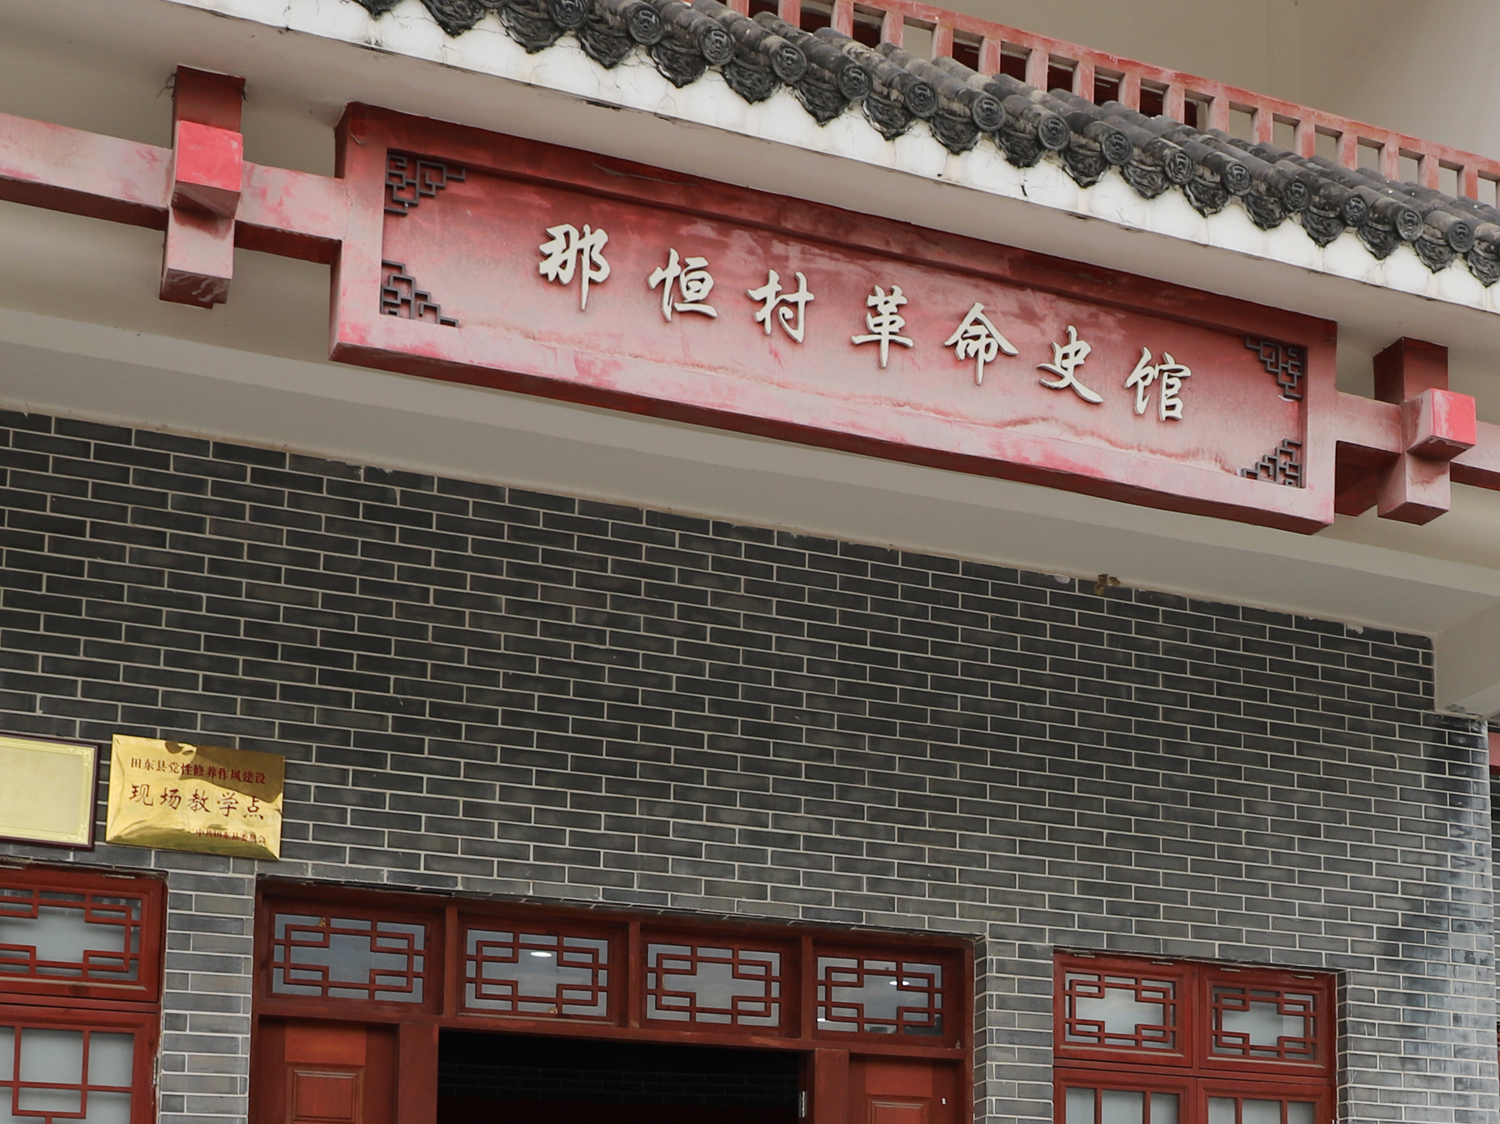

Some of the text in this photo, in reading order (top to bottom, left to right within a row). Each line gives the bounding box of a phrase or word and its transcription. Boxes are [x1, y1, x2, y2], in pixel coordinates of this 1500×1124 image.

[538, 222, 1193, 423] 那恒村革命史馆
[131, 757, 267, 785] 田东县党性修养作风建设
[129, 783, 264, 820] 现场教学点
